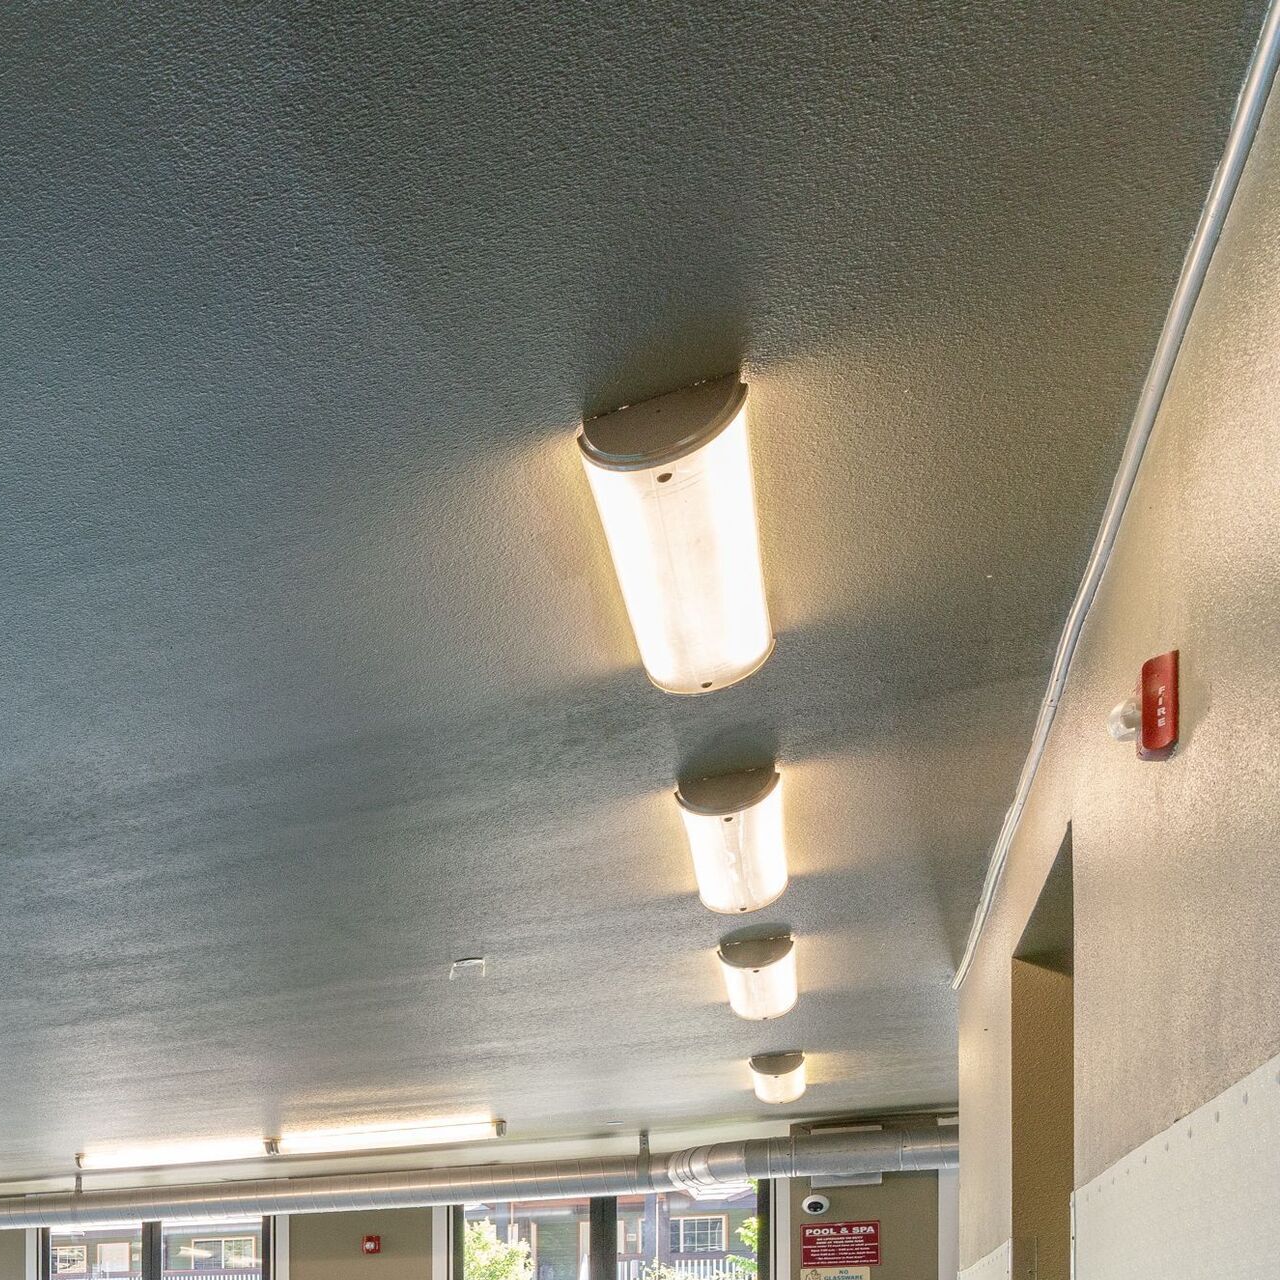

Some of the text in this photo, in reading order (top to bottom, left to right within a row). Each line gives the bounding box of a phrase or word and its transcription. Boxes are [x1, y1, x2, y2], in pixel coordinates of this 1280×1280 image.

[1156, 685, 1167, 727] FIRE
[805, 1228, 836, 1236] POOL
[852, 1225, 875, 1234] SPA
